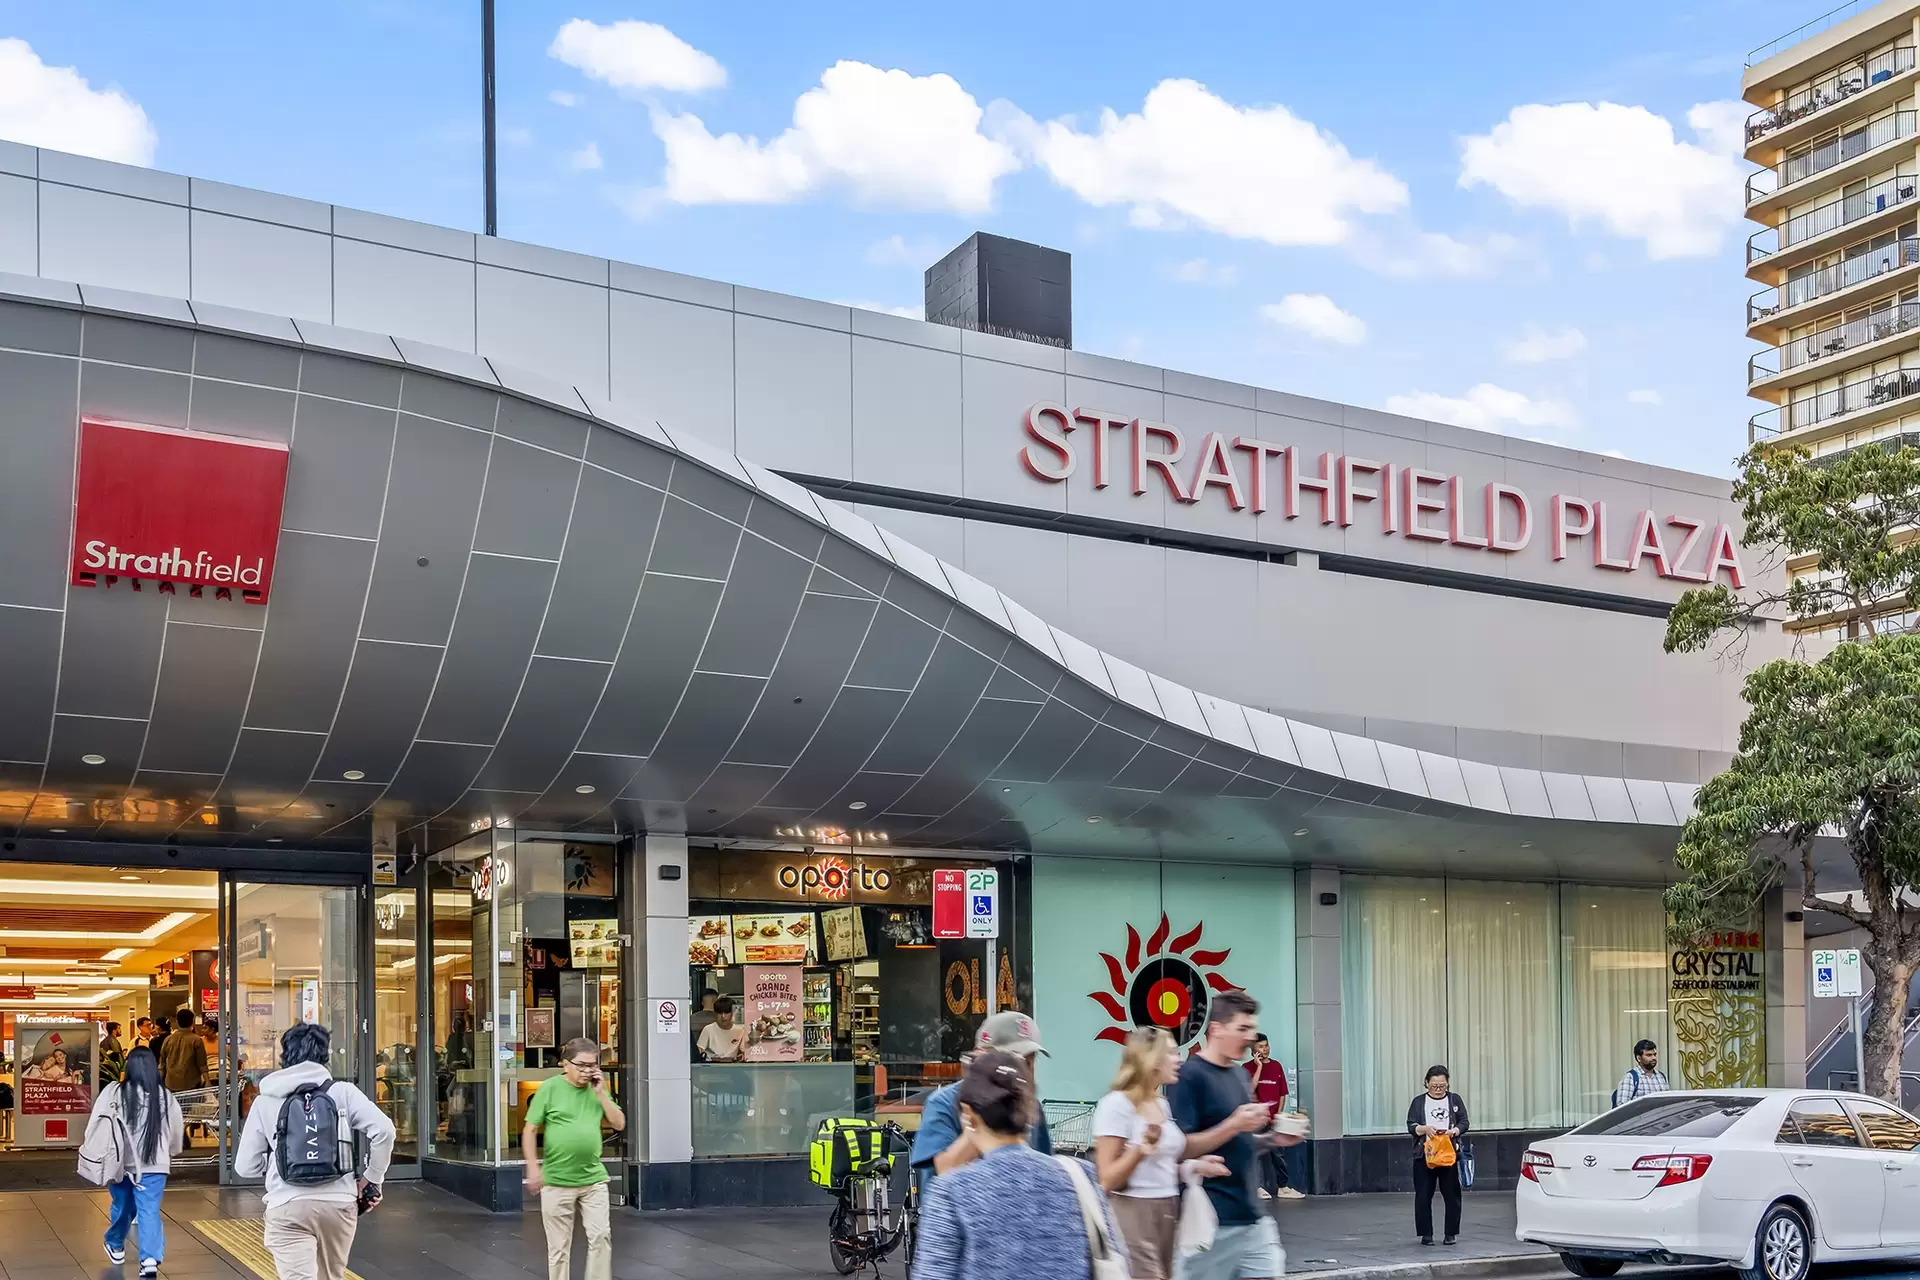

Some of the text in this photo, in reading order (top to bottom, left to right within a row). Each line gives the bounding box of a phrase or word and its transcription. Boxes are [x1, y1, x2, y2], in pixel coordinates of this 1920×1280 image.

[1019, 400, 1747, 590] STRATHFIELD PLAZA
[83, 540, 264, 585] Strathfield
[777, 856, 893, 900] oporto
[944, 874, 955, 883] NO
[969, 874, 995, 890] 2P
[937, 883, 962, 892] STOPPING
[1672, 950, 1760, 977] CRYSTAL
[1815, 953, 1834, 965] 2P
[759, 973, 787, 981] oporto
[756, 982, 790, 992] GRANDE
[1672, 980, 1760, 989] SEAFOOD RESTAURANT
[749, 991, 798, 1001] CHICKEN BITES
[757, 1002, 764, 1011] 5
